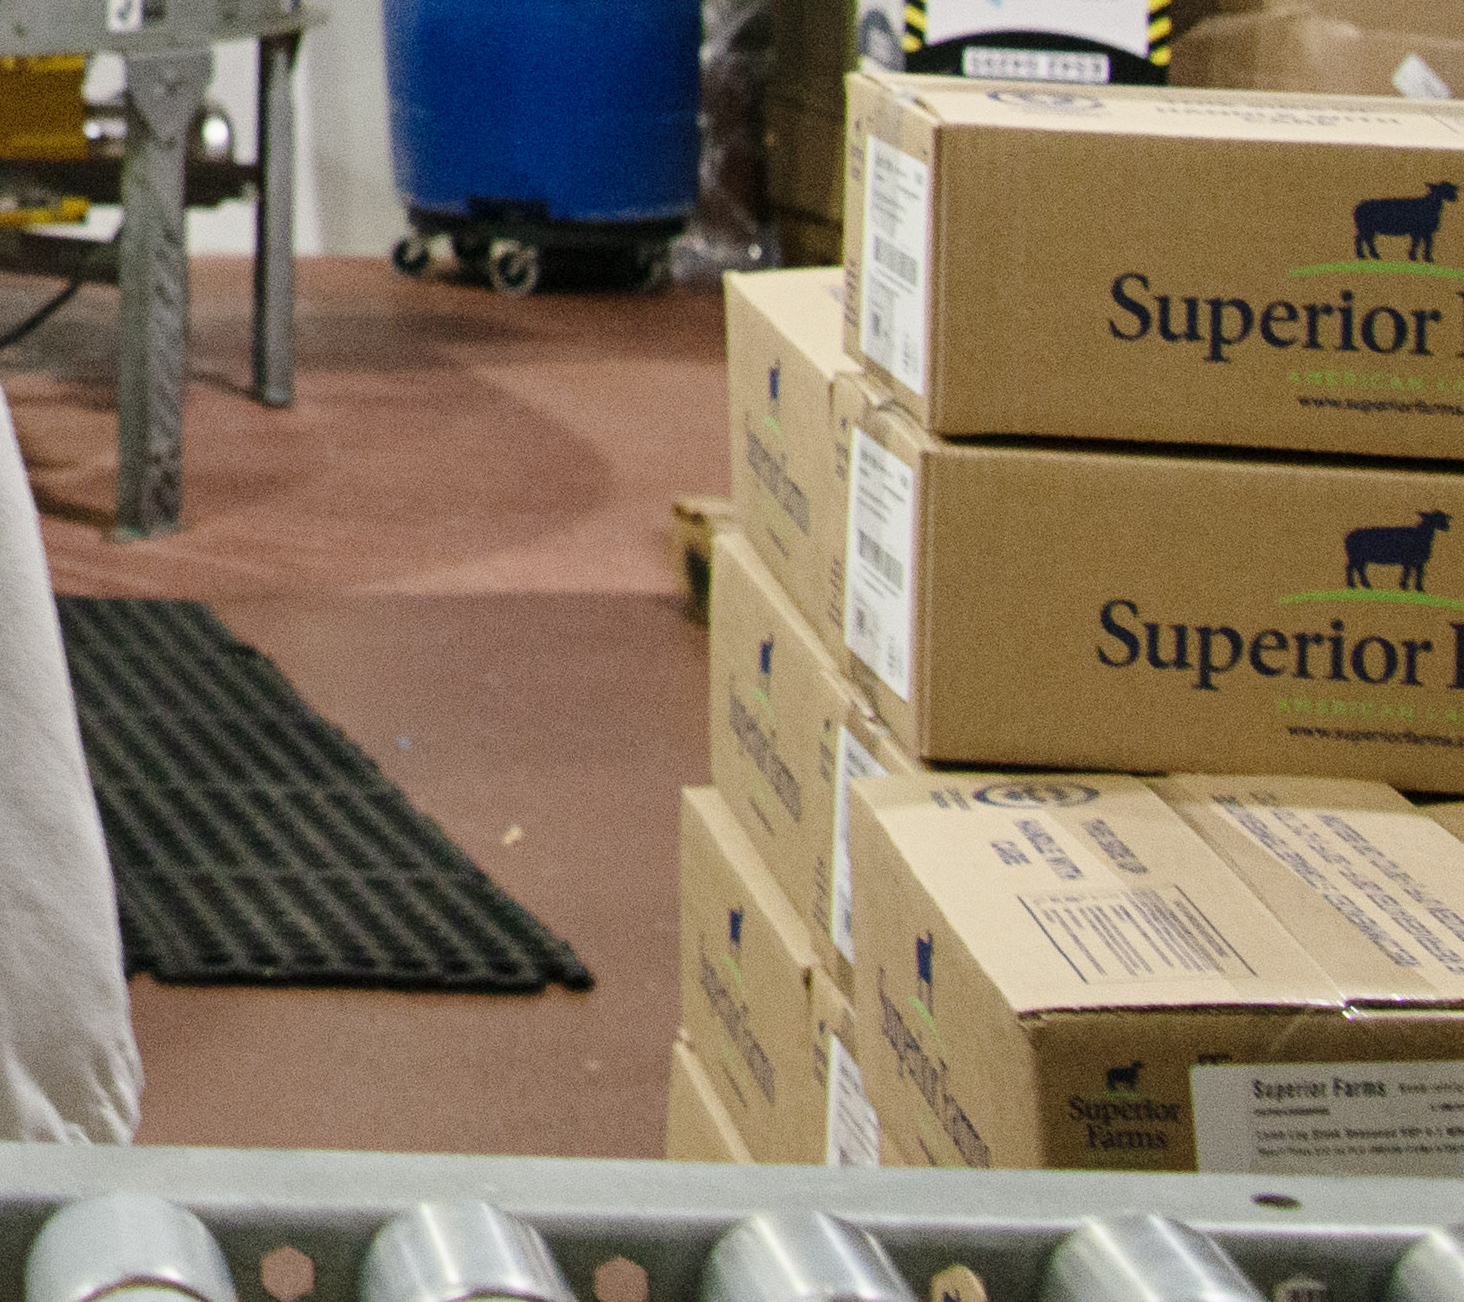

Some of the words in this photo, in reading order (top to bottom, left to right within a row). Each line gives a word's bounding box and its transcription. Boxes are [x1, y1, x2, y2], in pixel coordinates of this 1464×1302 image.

[1108, 272, 1443, 363] Superior
[1095, 599, 1434, 691] Superior
[1252, 1078, 1327, 1102] Superior
[1333, 1076, 1388, 1098] Farms
[1068, 1095, 1181, 1127] Superior
[1086, 1124, 1168, 1150] Farms
